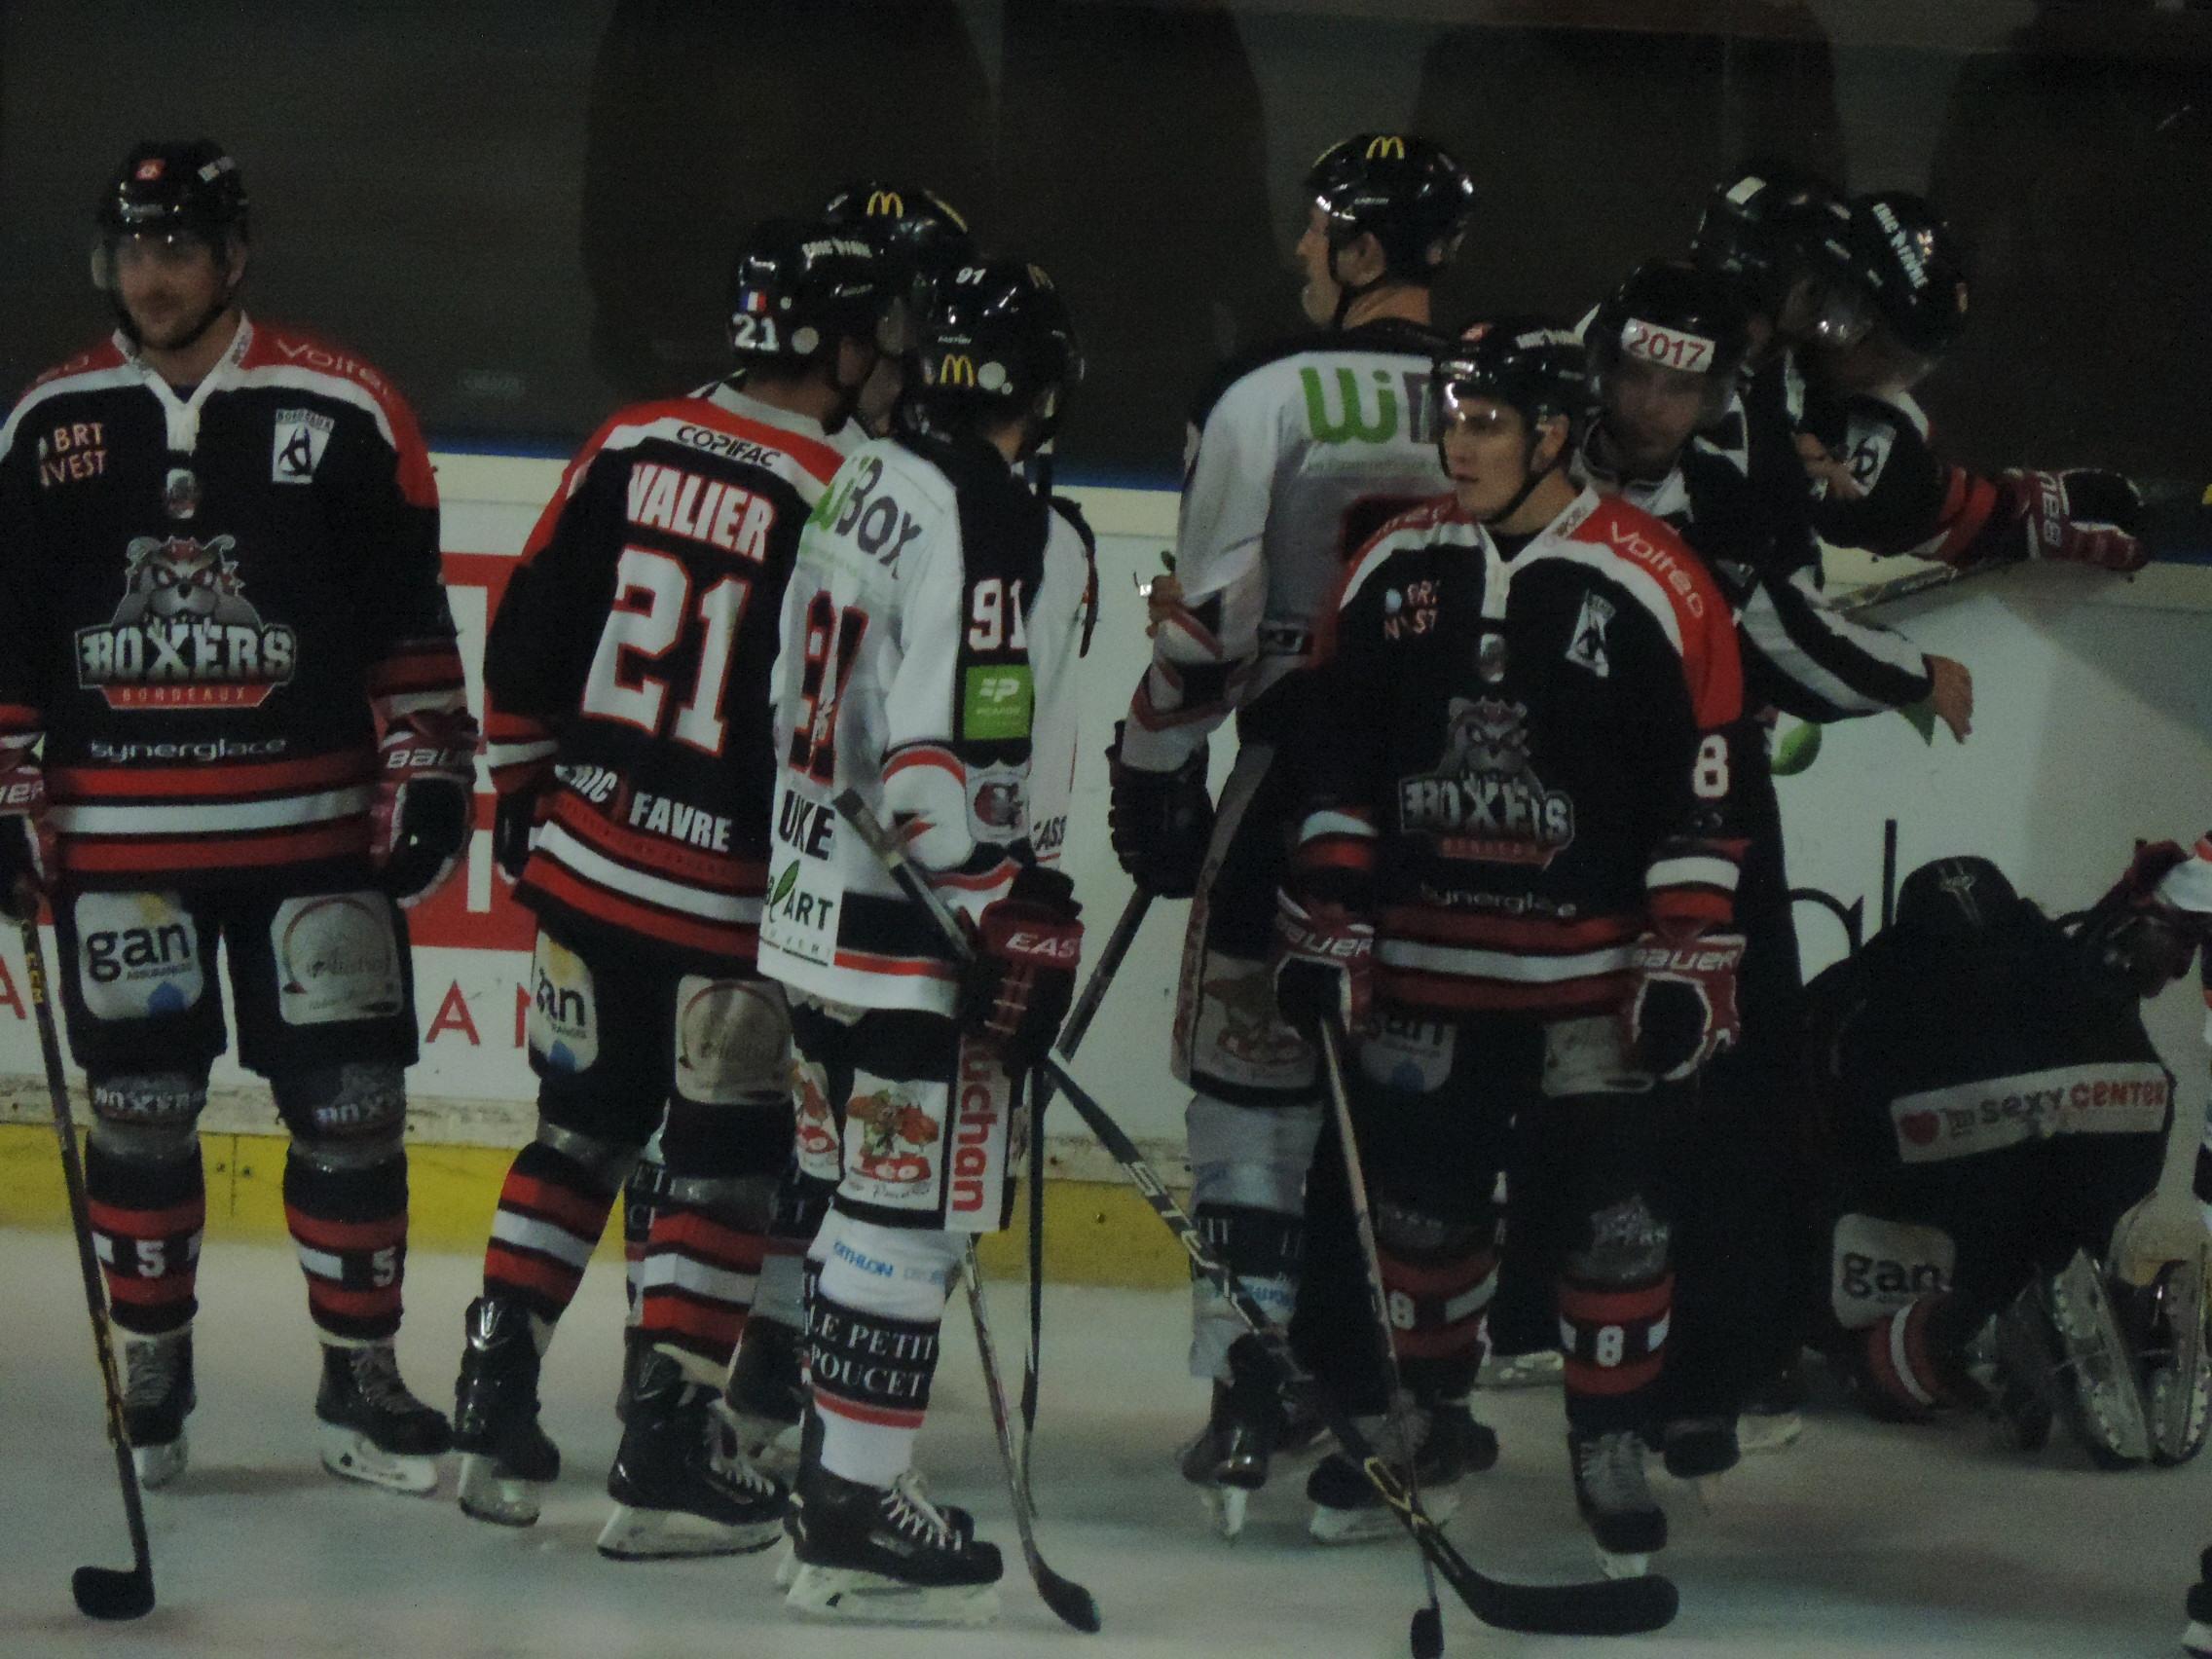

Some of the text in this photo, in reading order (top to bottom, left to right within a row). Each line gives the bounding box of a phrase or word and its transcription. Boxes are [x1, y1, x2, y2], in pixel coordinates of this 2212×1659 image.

[732, 313, 780, 351] 21
[1629, 326, 1707, 367] 2017
[677, 425, 780, 466] COPIFAC
[627, 461, 775, 563] VALIER
[968, 578, 1029, 650] 91
[82, 617, 292, 682] BOXERS
[581, 544, 752, 758] 21
[123, 686, 245, 703] BORDEAUX
[1691, 733, 1730, 799] 8
[628, 791, 732, 853] FAVRE
[87, 923, 191, 983] gan
[136, 1238, 166, 1278] 5
[372, 1246, 398, 1288] 5
[1389, 1289, 1416, 1331] 8
[810, 1343, 926, 1398] POUCET
[1597, 1325, 1625, 1368] 8
